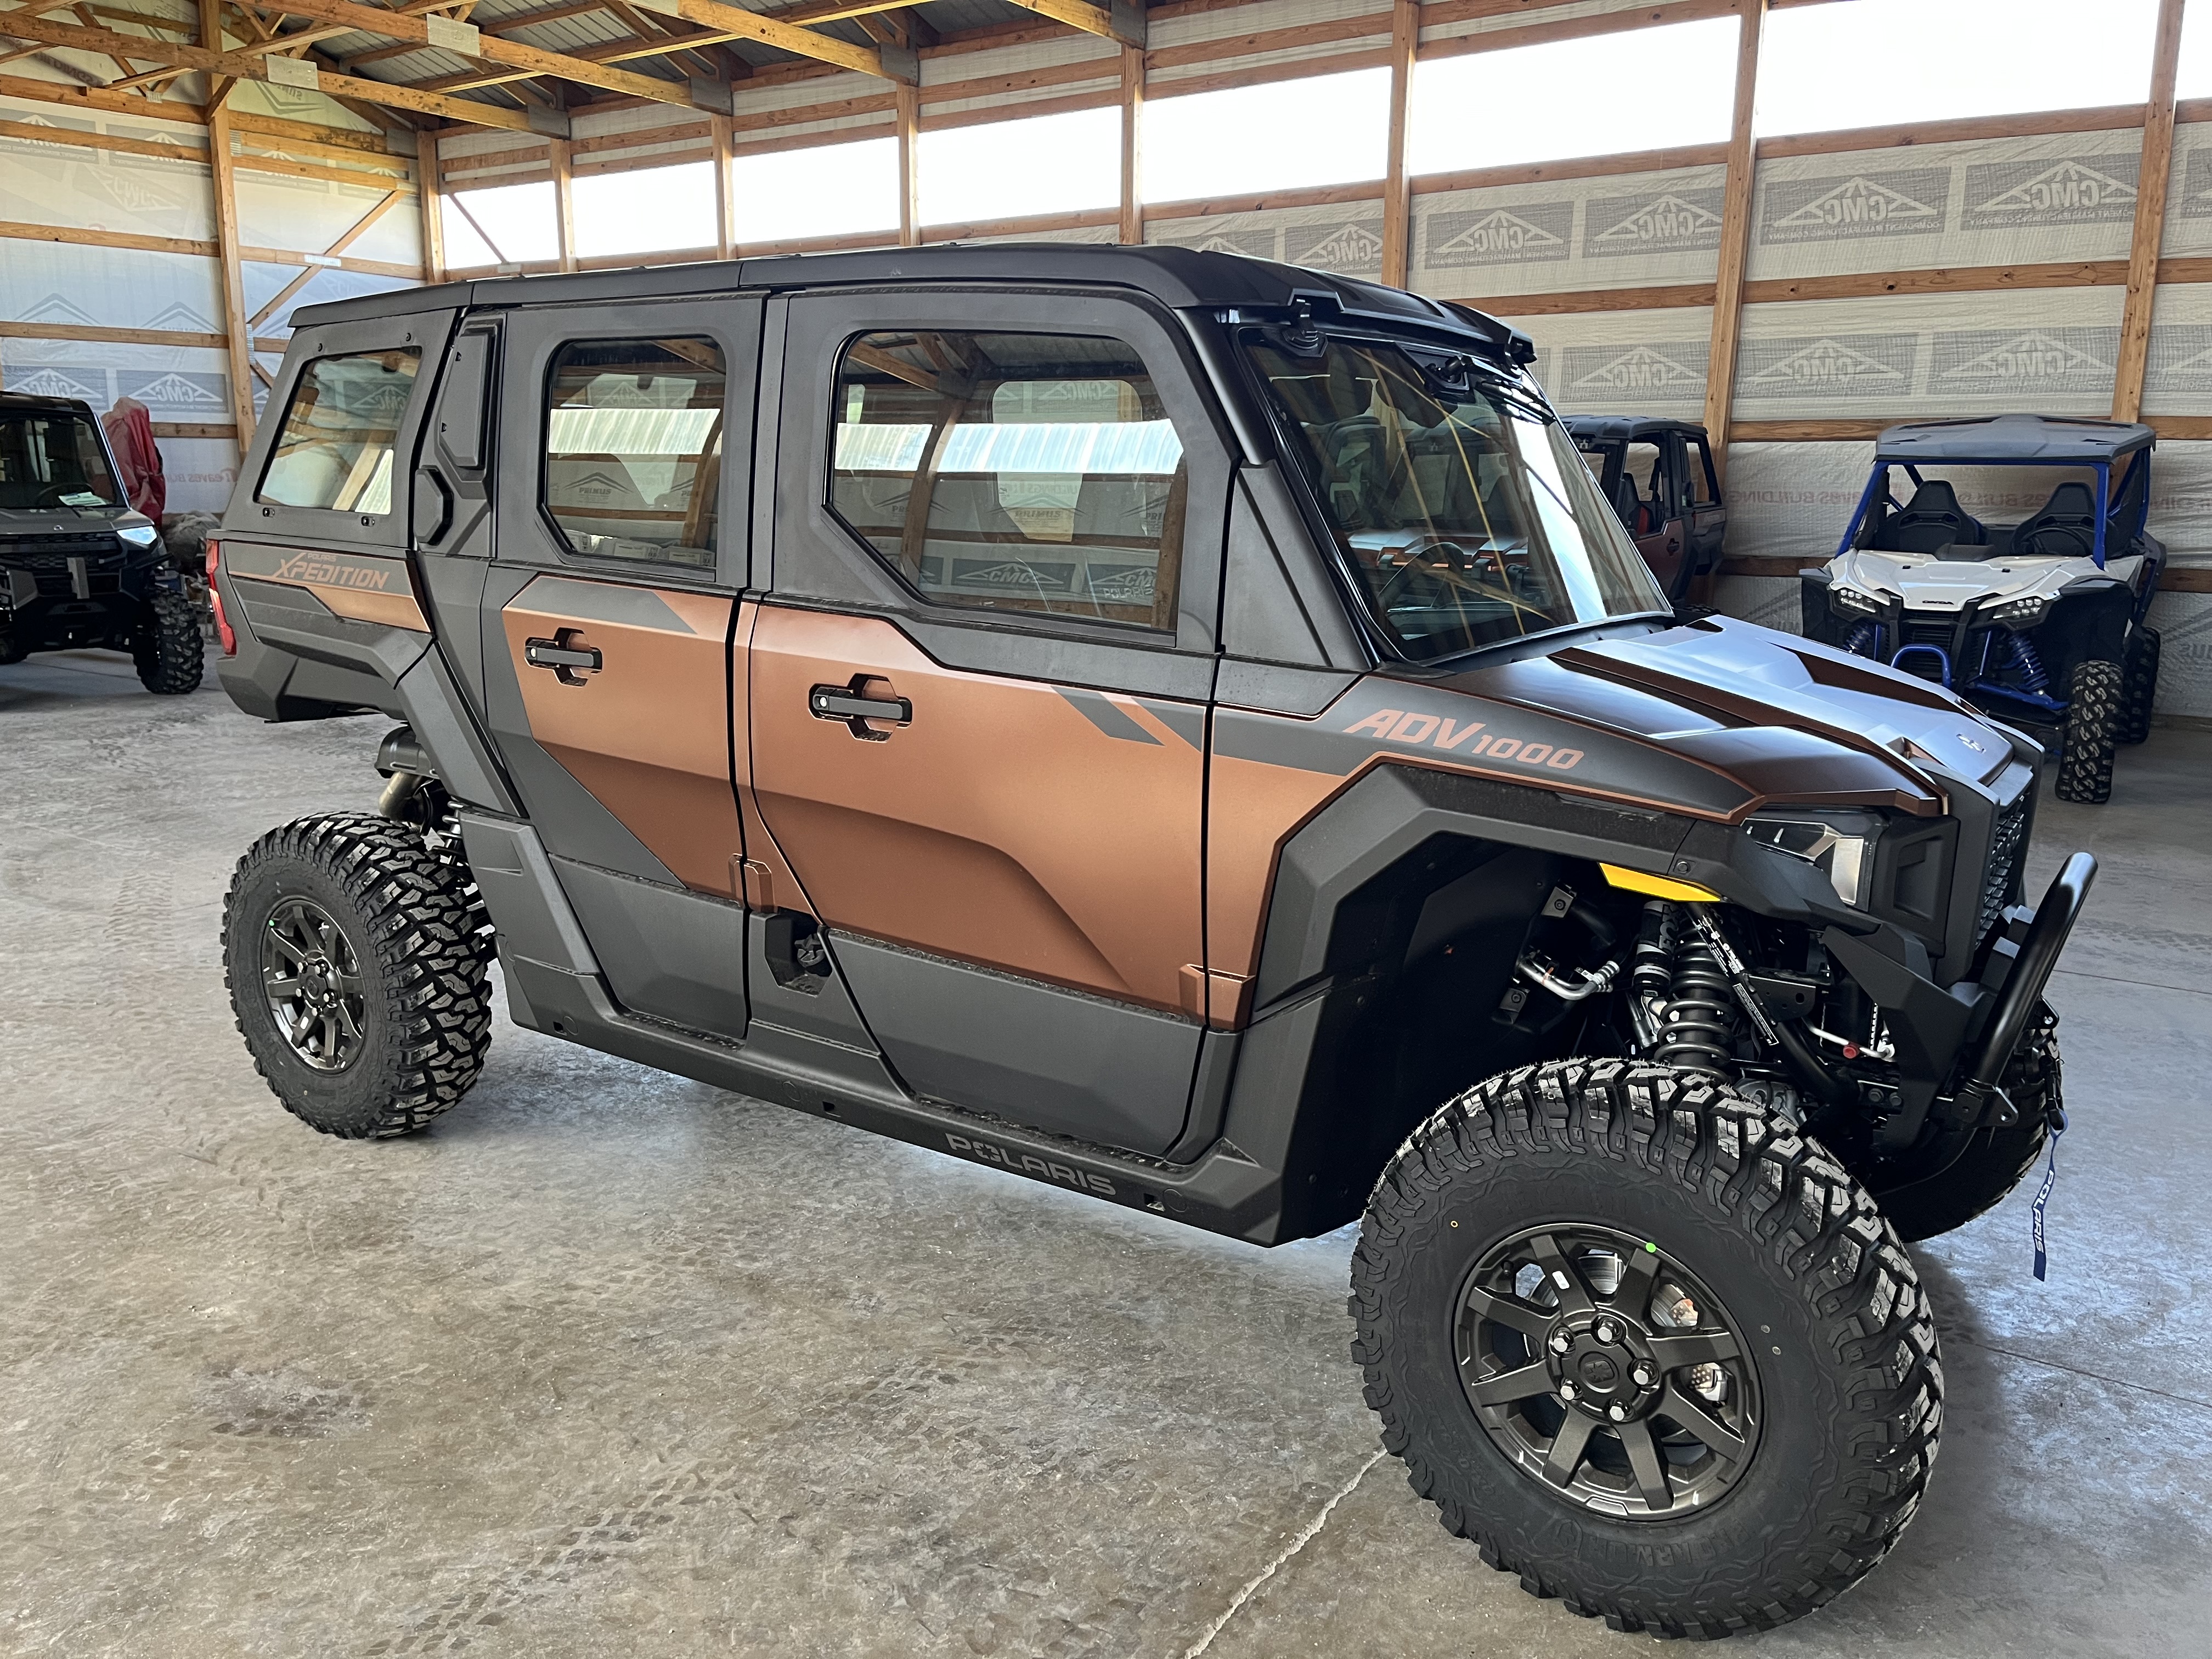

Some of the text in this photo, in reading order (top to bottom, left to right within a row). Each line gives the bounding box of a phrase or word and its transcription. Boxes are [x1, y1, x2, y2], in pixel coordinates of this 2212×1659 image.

[578, 487, 612, 495] PRIMUS
[272, 552, 390, 589] XPEDITION
[307, 552, 337, 562] POLARIS
[989, 571, 1034, 583] CMC
[1343, 709, 1584, 769] ADV 1000
[945, 1133, 1116, 1196] POLARIS
[2033, 1169, 2055, 1254] POLARIS
